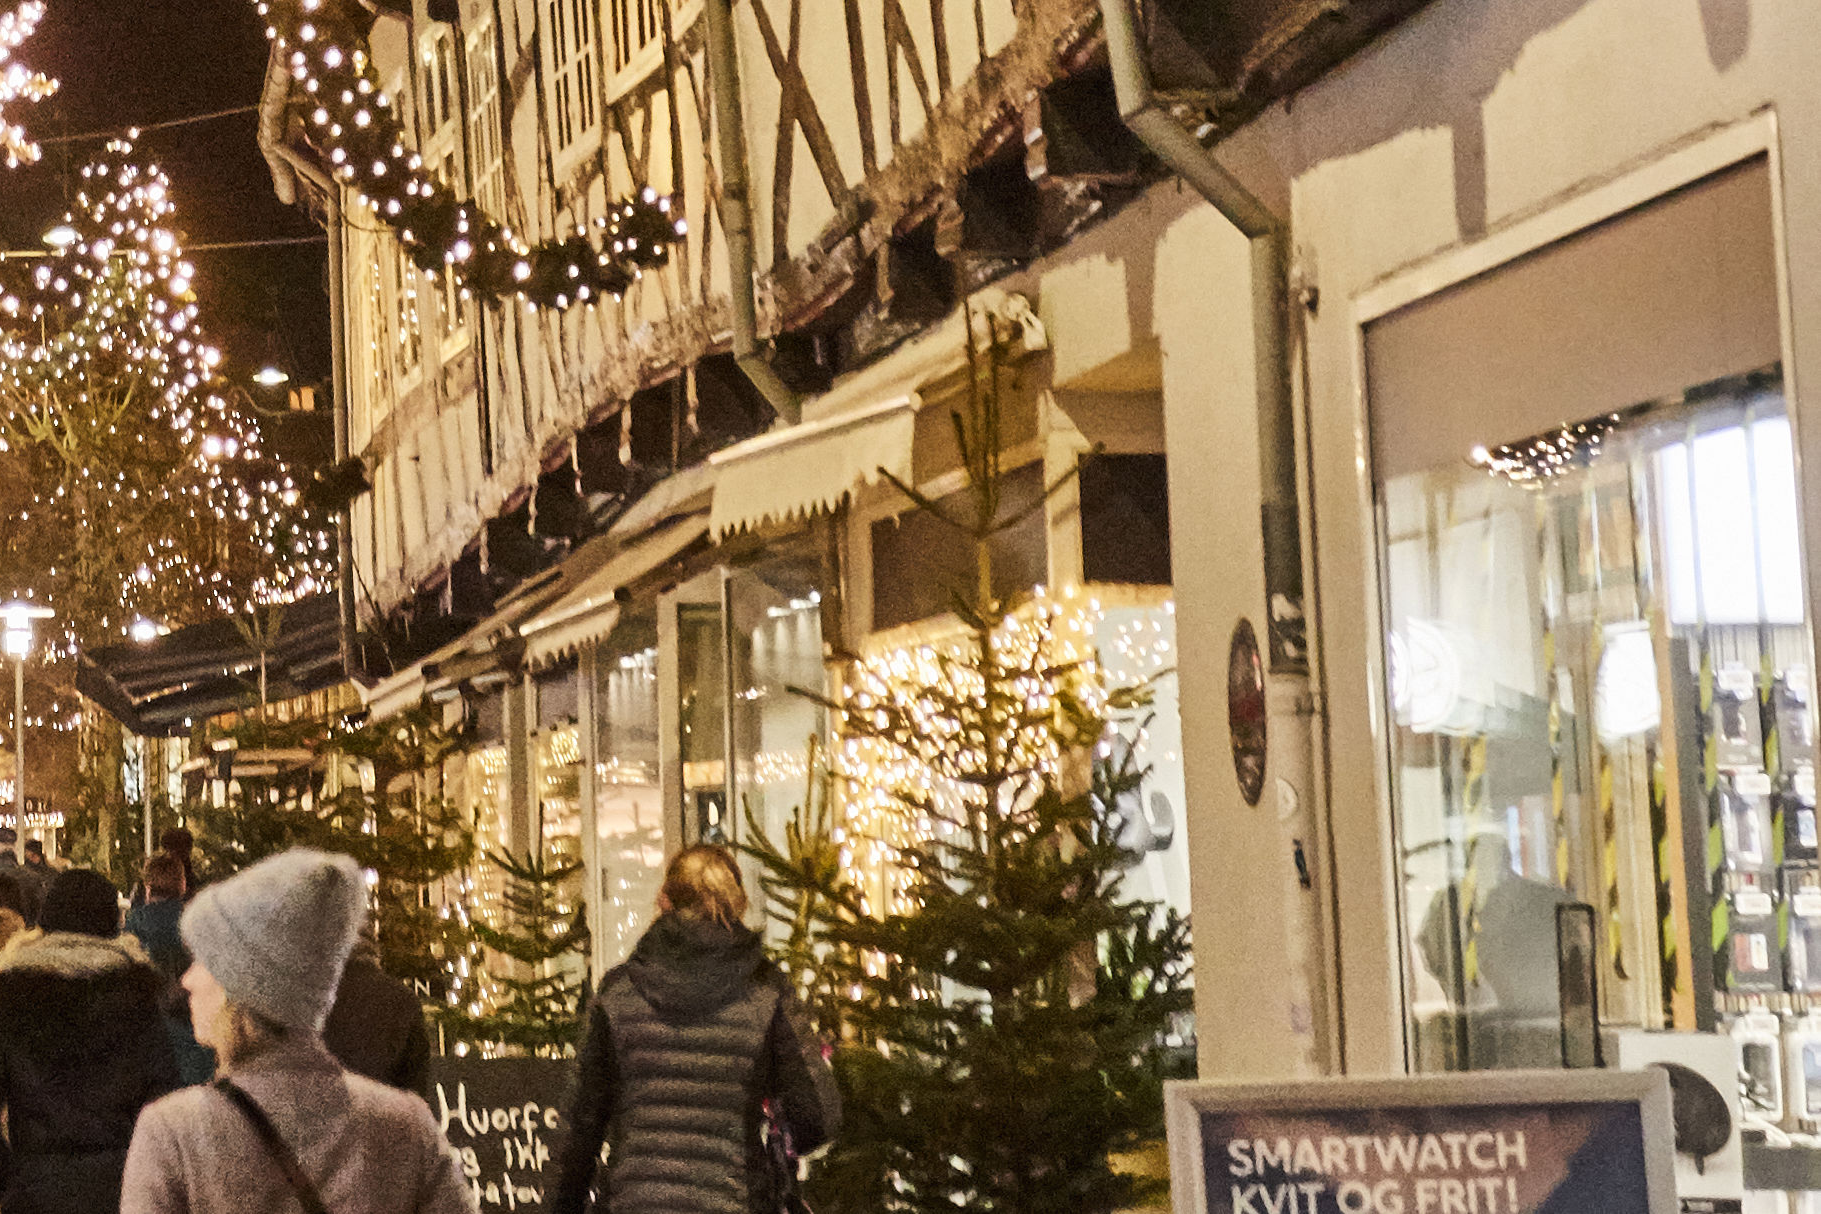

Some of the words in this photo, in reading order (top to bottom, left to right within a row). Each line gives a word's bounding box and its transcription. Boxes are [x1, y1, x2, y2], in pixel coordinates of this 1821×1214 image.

[1228, 1130, 1527, 1177] SMARTWATCH
[1231, 1183, 1326, 1214] KVIT
[1336, 1179, 1405, 1214] OG
[1415, 1175, 1520, 1214] FRIT!
